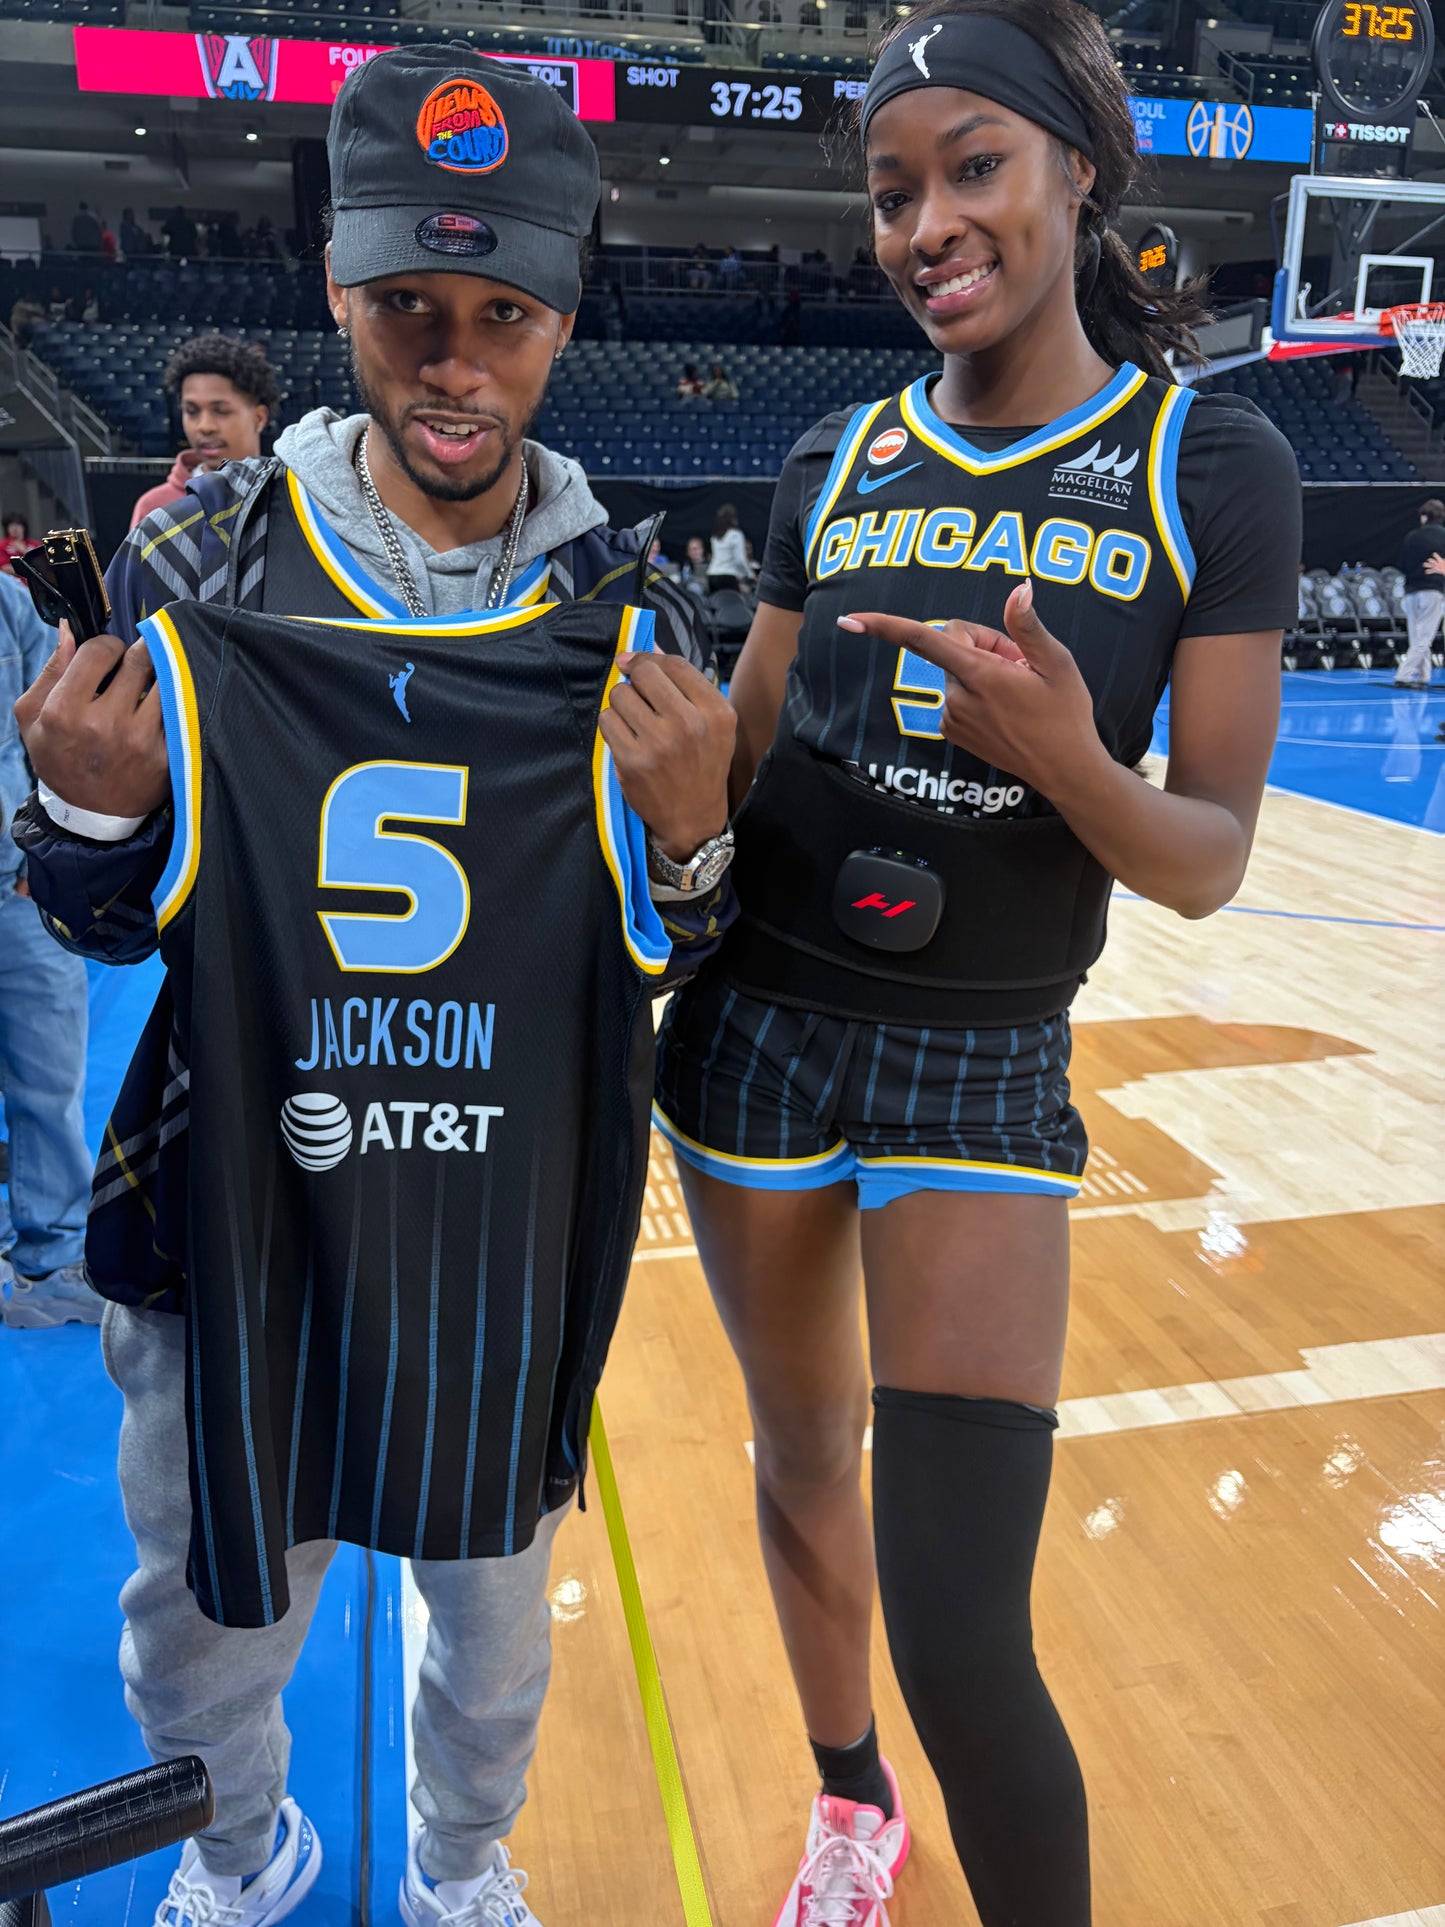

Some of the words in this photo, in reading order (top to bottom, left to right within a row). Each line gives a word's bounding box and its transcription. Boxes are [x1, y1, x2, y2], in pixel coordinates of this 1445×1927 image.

[1342, 3, 1415, 40] 37:25
[627, 66, 680, 87] SHOT
[711, 81, 802, 120] 37:25
[432, 111, 481, 139] FROM
[437, 130, 452, 140] THE
[1348, 124, 1410, 143] TISSOT
[428, 126, 504, 164] COURT
[1051, 472, 1132, 496] MAGELLAN
[816, 507, 1151, 601] CHICAGO
[317, 759, 471, 974] 5
[294, 997, 496, 1071] JACKSON
[360, 1101, 504, 1155] AT&T
